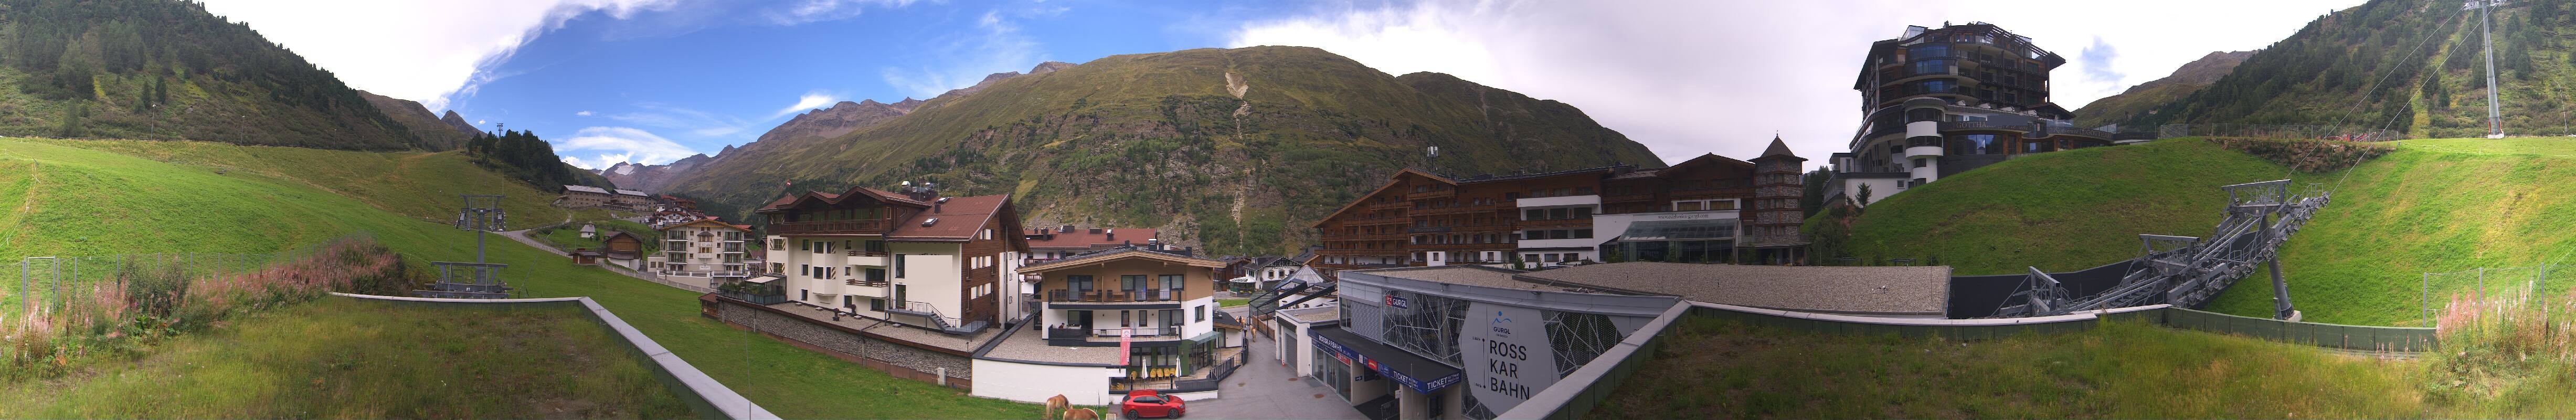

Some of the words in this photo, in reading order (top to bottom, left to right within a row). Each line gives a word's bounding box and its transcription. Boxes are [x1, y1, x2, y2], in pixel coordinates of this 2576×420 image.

[1393, 299, 1407, 307] GURGL
[1319, 335, 1342, 352] ROSSKARBAHN
[1490, 340, 1526, 361] ROSS
[1393, 371, 1408, 383] TICKET
[1490, 358, 1518, 379] KAR
[1427, 377, 1448, 390] TICKET
[1491, 377, 1530, 400] BAHN
